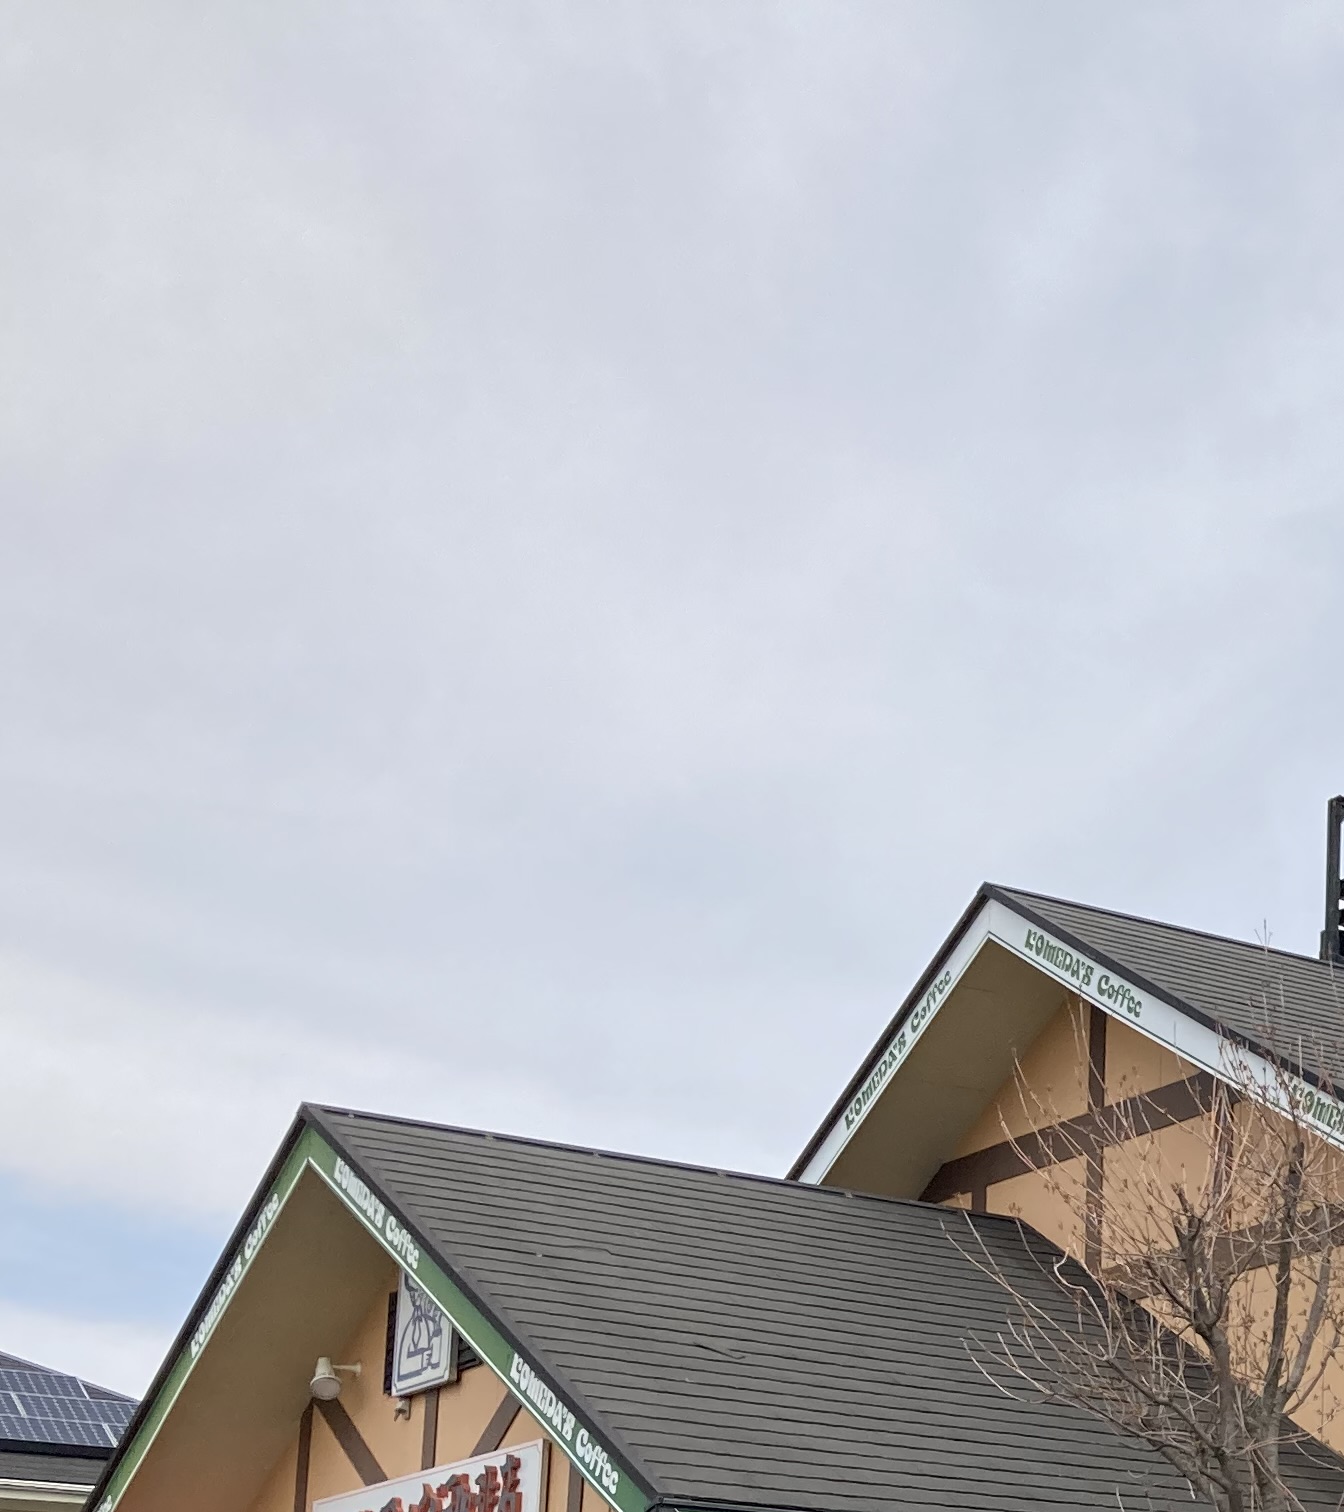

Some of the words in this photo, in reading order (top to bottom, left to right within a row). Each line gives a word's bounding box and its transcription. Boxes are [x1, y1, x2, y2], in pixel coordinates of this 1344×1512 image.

[1025, 929, 1094, 987] KOMEDA'S
[1097, 975, 1143, 1019] Coffee
[845, 1031, 907, 1131] KOMEDA'S
[910, 970, 953, 1035] Coffee
[334, 1157, 384, 1228] KOMEDA'S
[385, 1215, 420, 1270] Coffee
[509, 1352, 574, 1443] KOMEDA'S
[575, 1434, 619, 1495] Coffee
